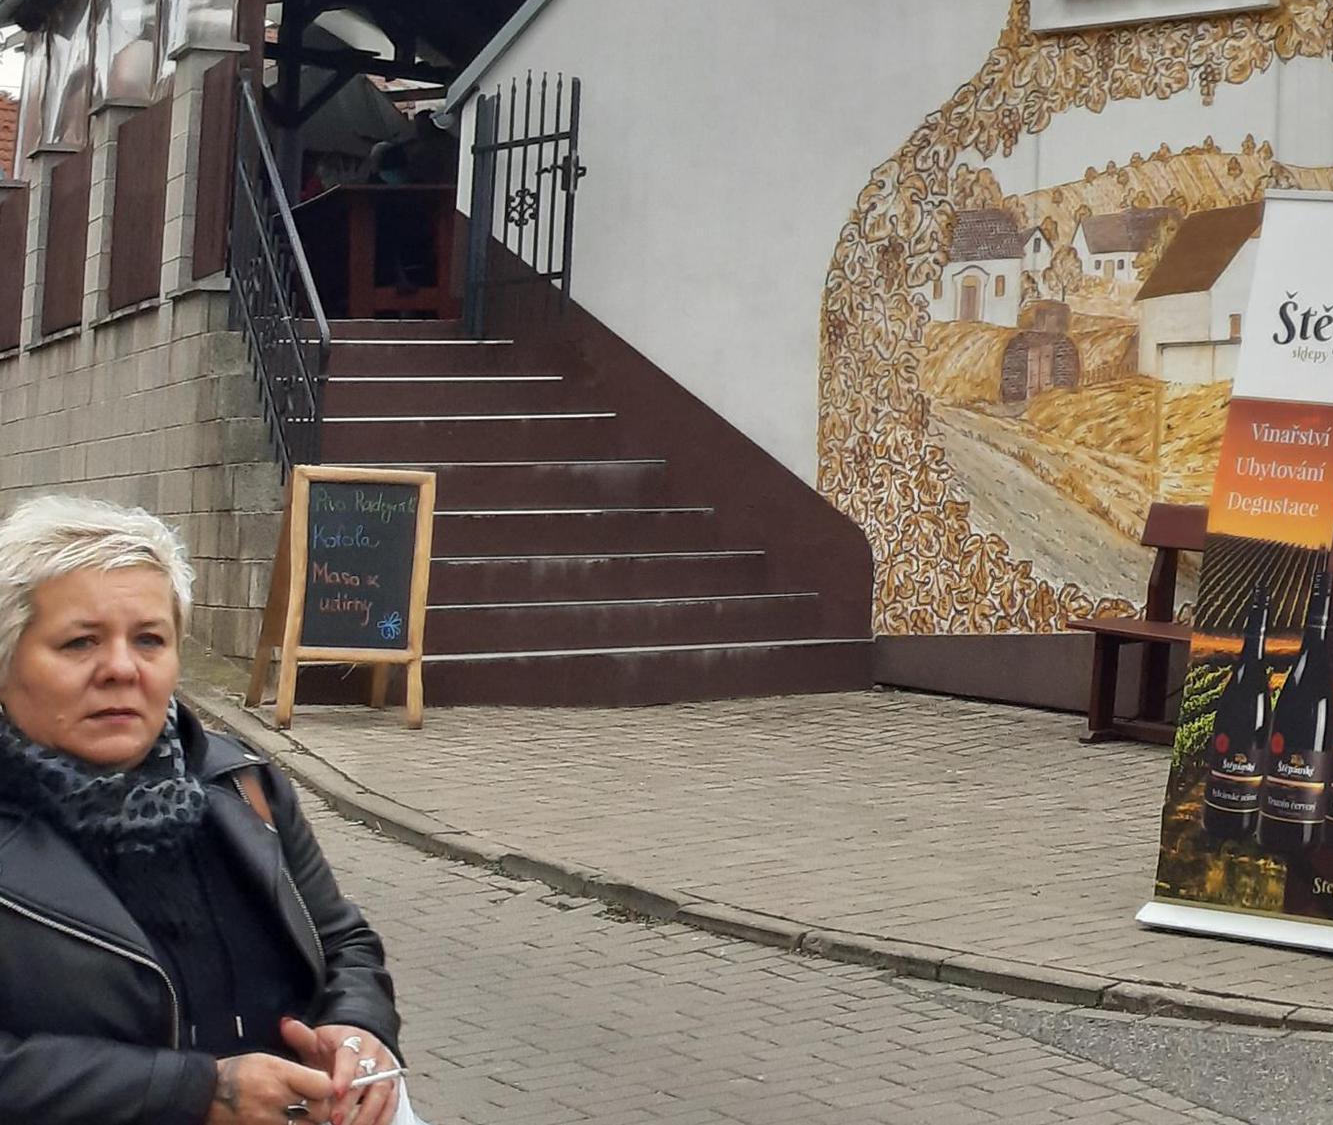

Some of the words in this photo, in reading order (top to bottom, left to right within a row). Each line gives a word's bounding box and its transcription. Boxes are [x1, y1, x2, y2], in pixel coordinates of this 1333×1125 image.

[1291, 346, 1329, 364] sklepy
[1251, 423, 1332, 447] Vinařství
[1235, 456, 1327, 482] Ubytování
[1227, 491, 1320, 517] Degustace
[312, 561, 360, 587] Maso
